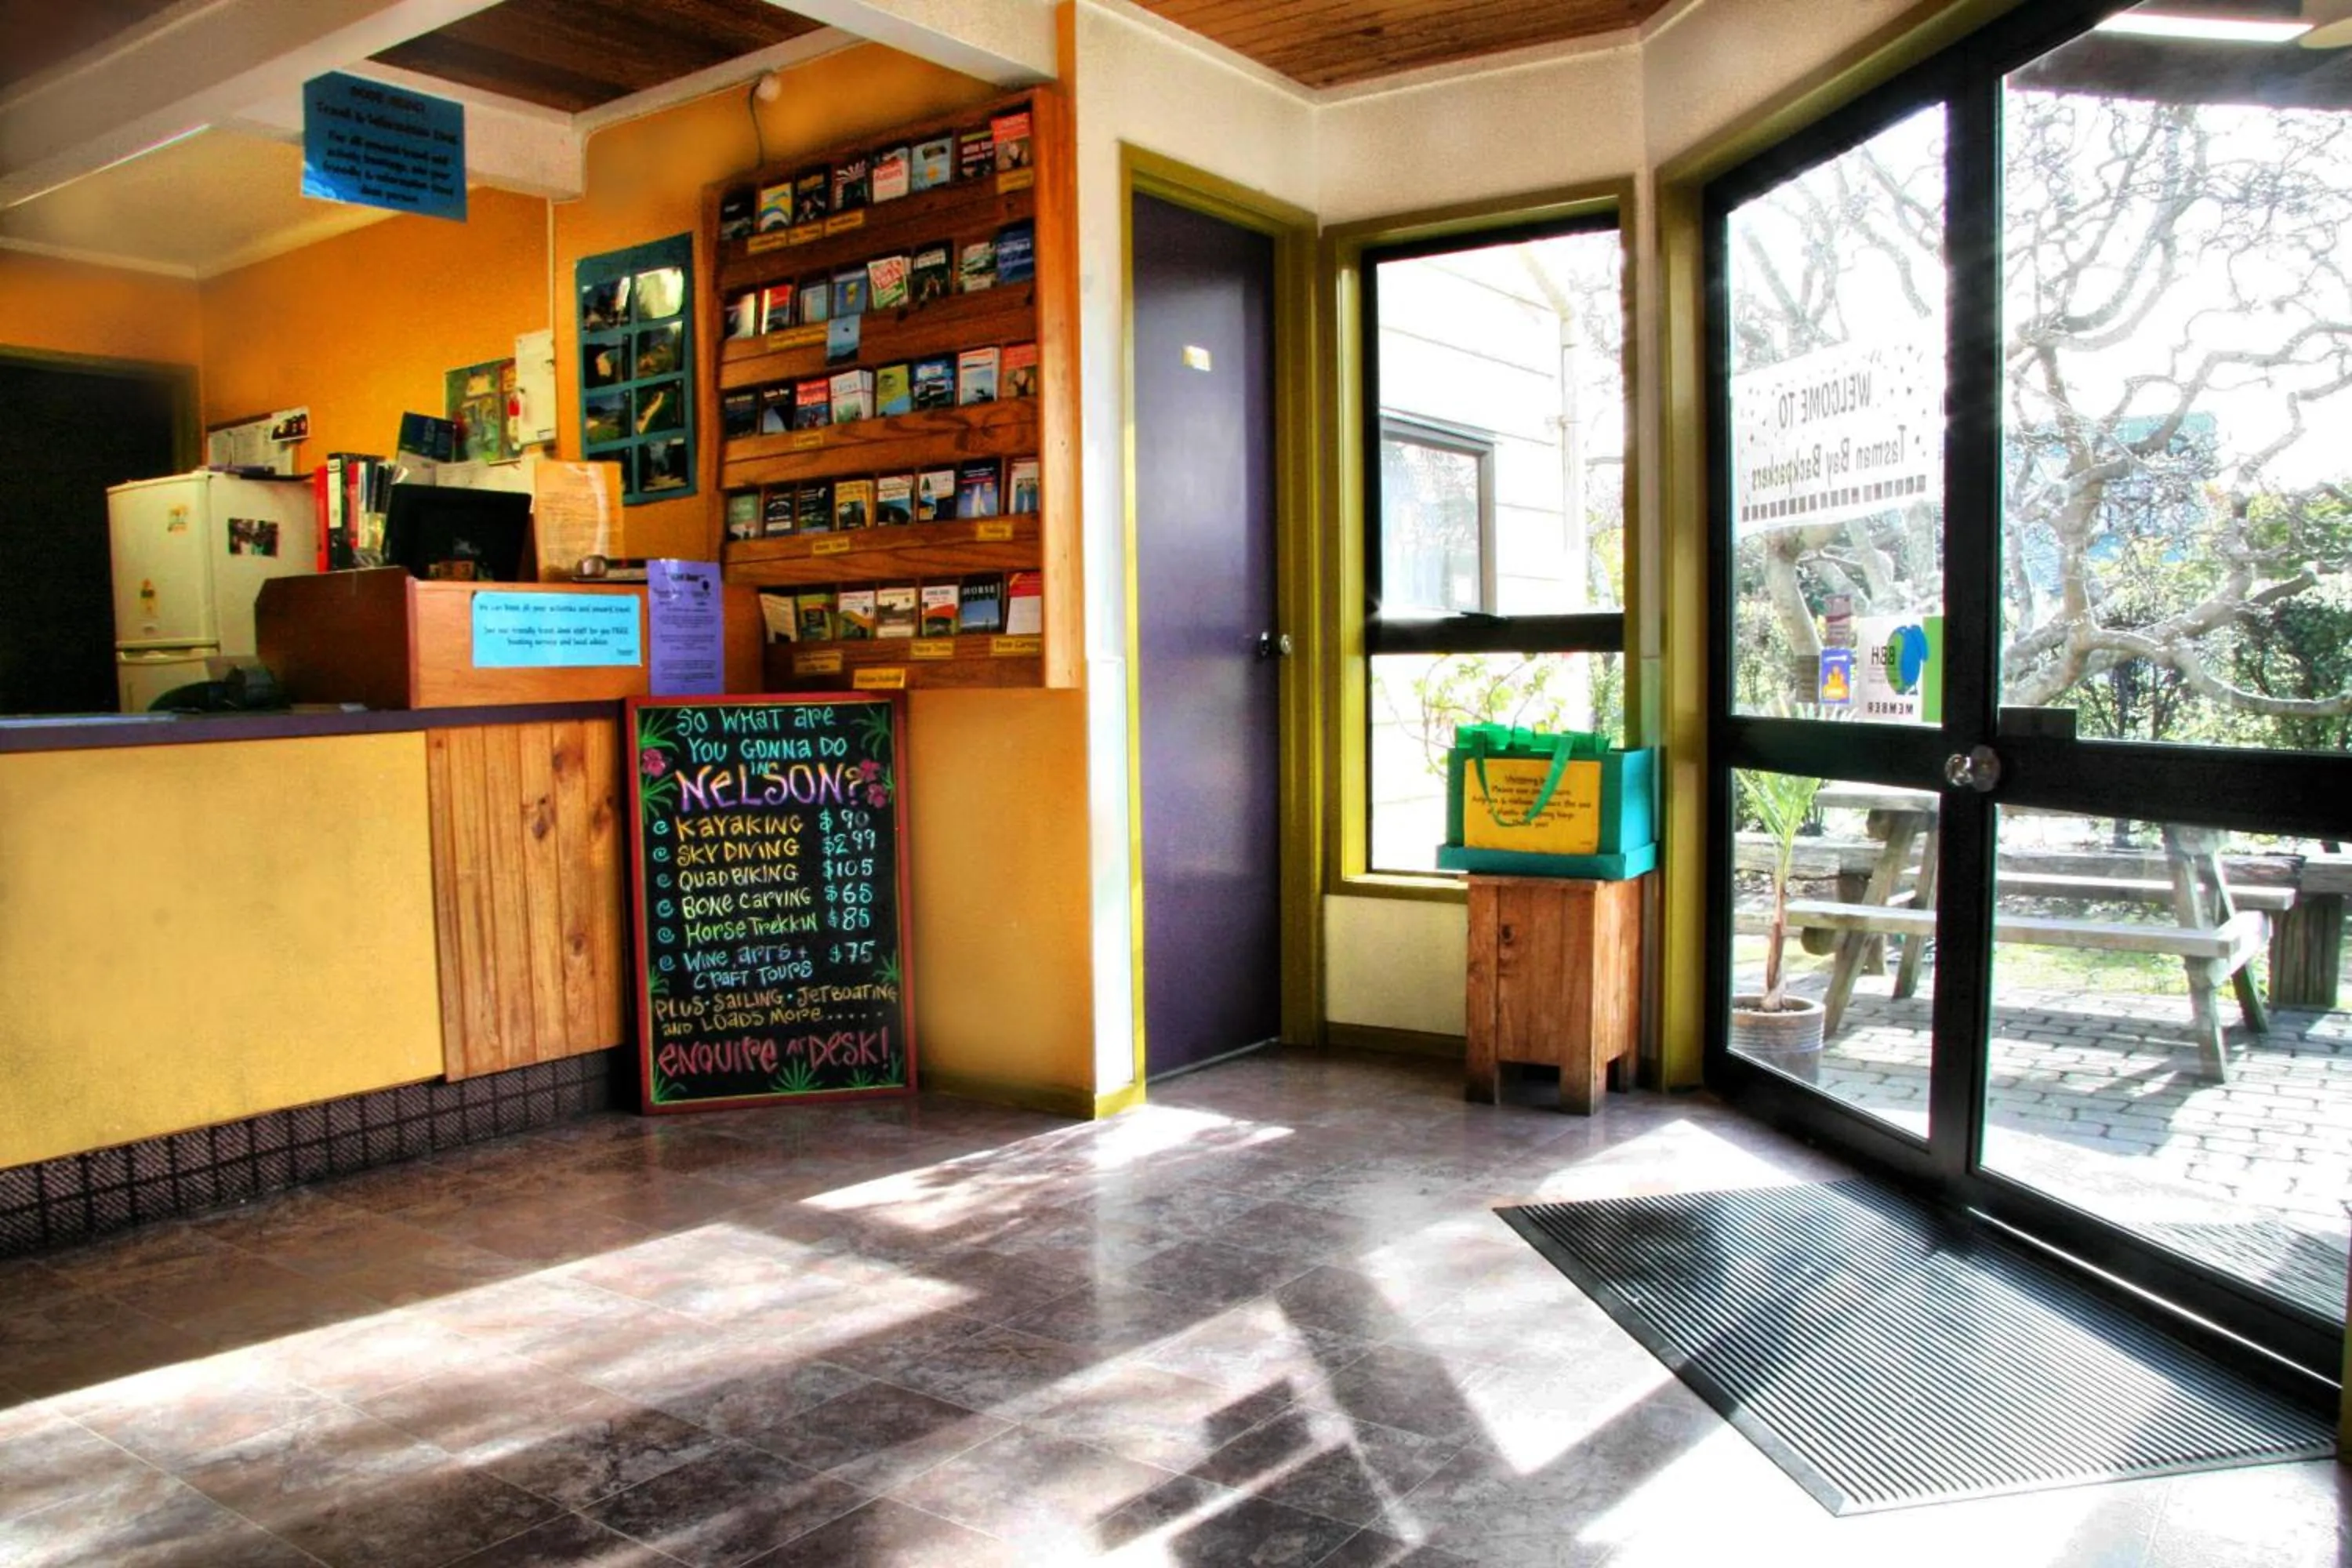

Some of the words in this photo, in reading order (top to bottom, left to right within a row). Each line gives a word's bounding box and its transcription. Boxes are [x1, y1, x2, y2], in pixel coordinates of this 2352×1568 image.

[963, 585, 996, 594] HORSE
[822, 828, 876, 855] $299
[822, 858, 874, 880] $105
[829, 940, 876, 964] $75
